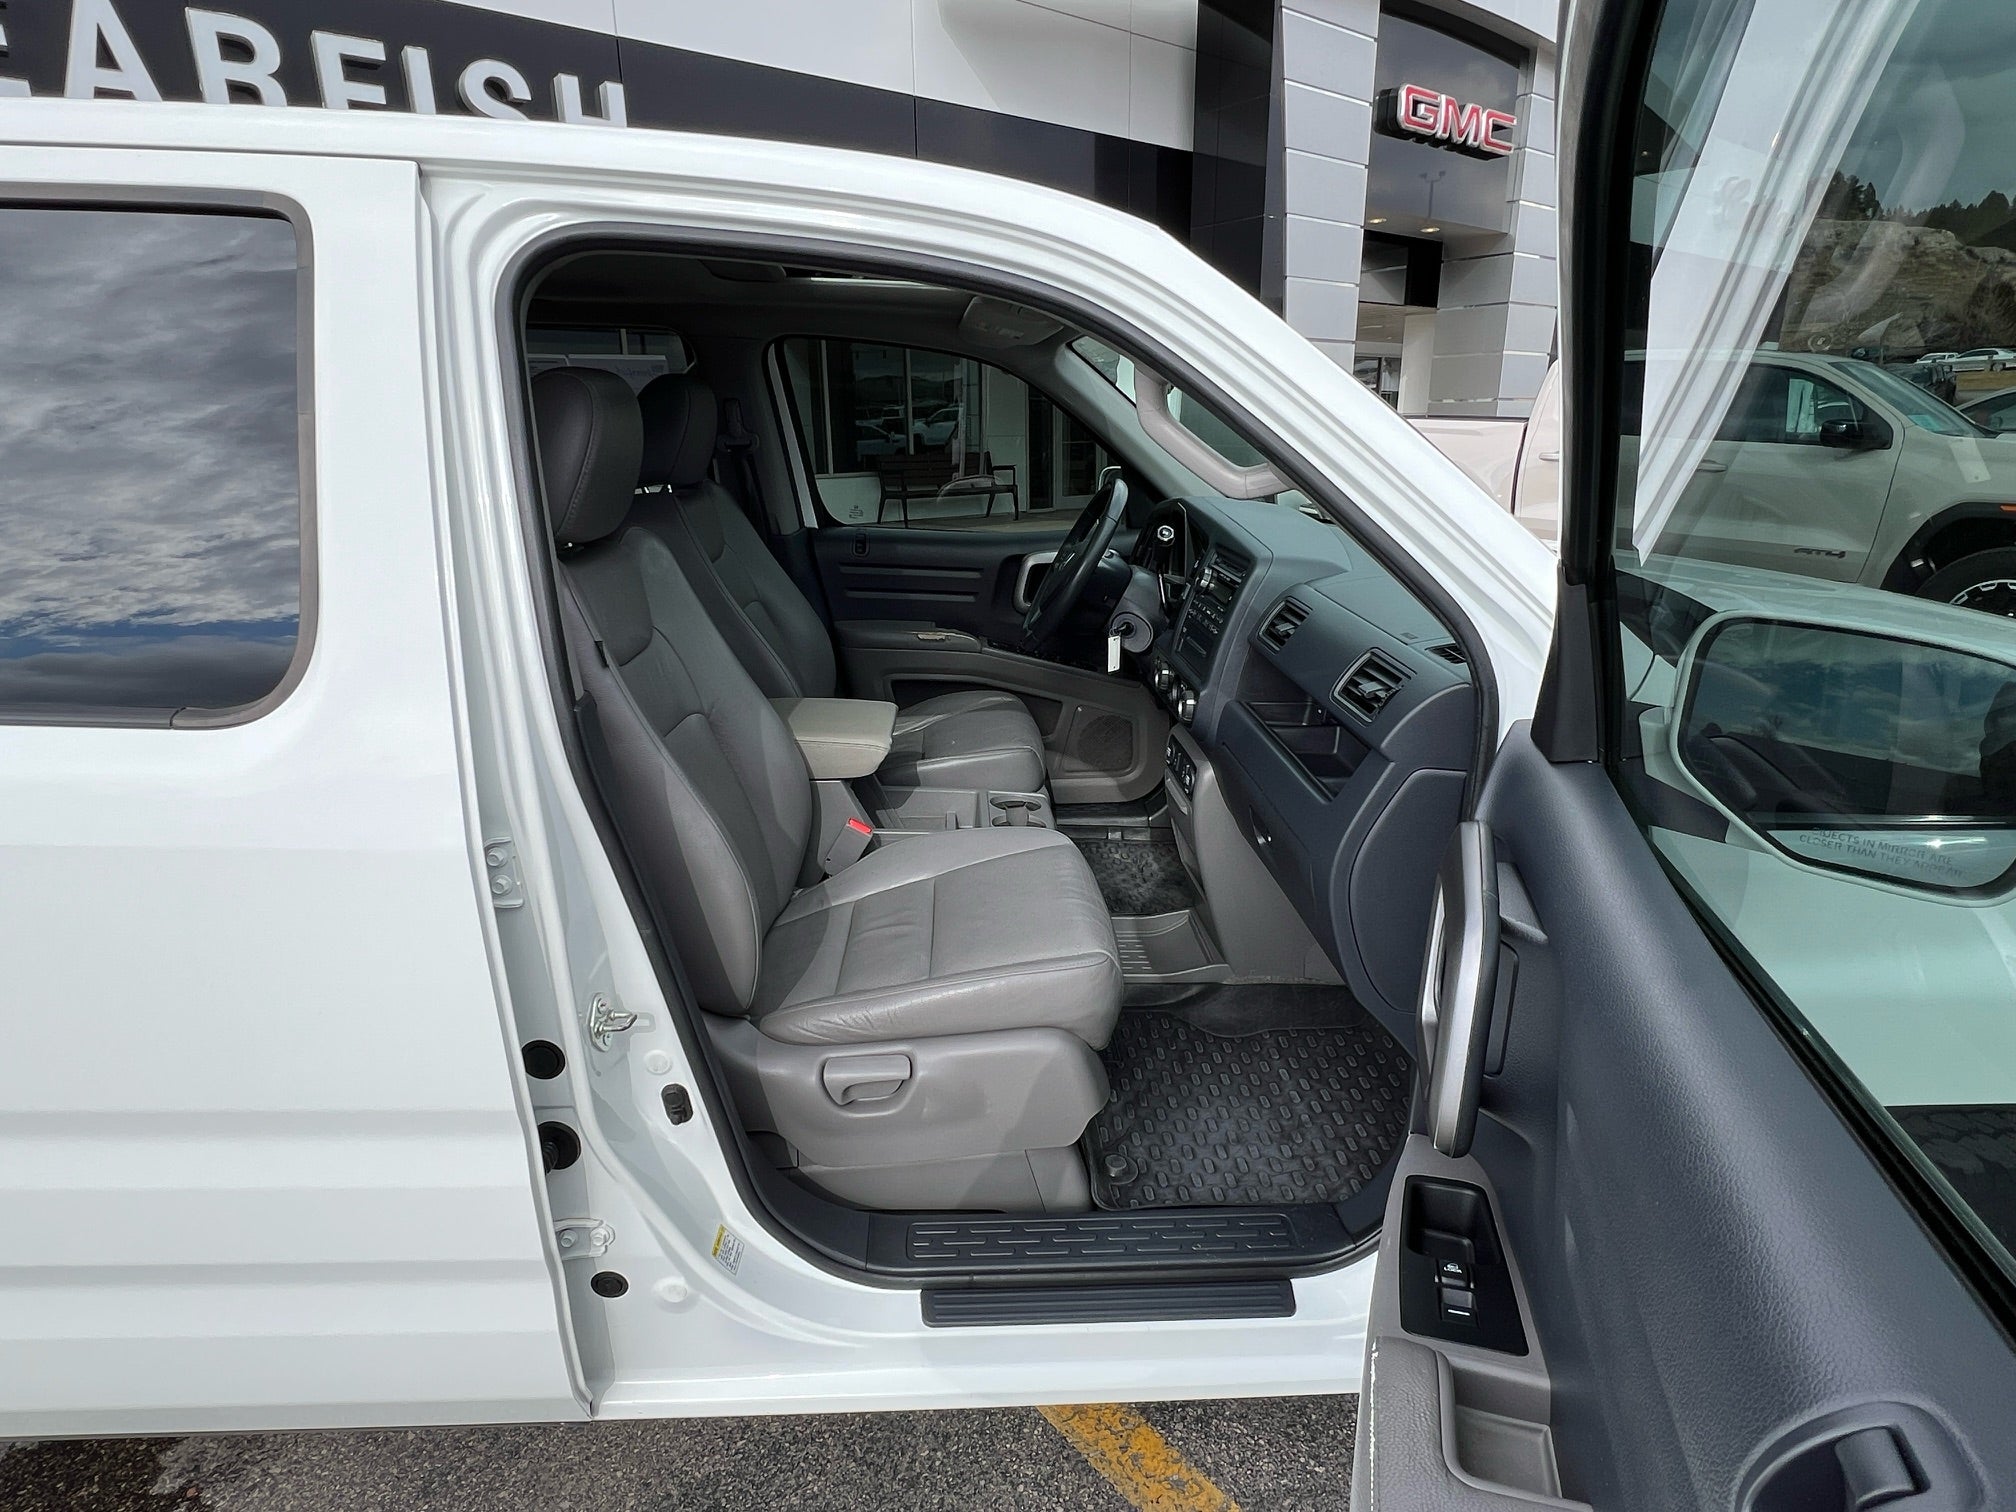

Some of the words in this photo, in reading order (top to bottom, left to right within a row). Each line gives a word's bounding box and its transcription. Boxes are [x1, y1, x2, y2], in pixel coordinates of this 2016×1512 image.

[0, 0, 627, 128] ARFISH
[1398, 83, 1517, 156] GMC
[1799, 834, 1843, 851] CLOSER
[1846, 844, 1877, 858] THAN
[1880, 852, 1911, 865] THEY
[1862, 838, 1876, 849] IN
[1877, 841, 1926, 859] MIRROR
[1928, 853, 1952, 865] ARE
